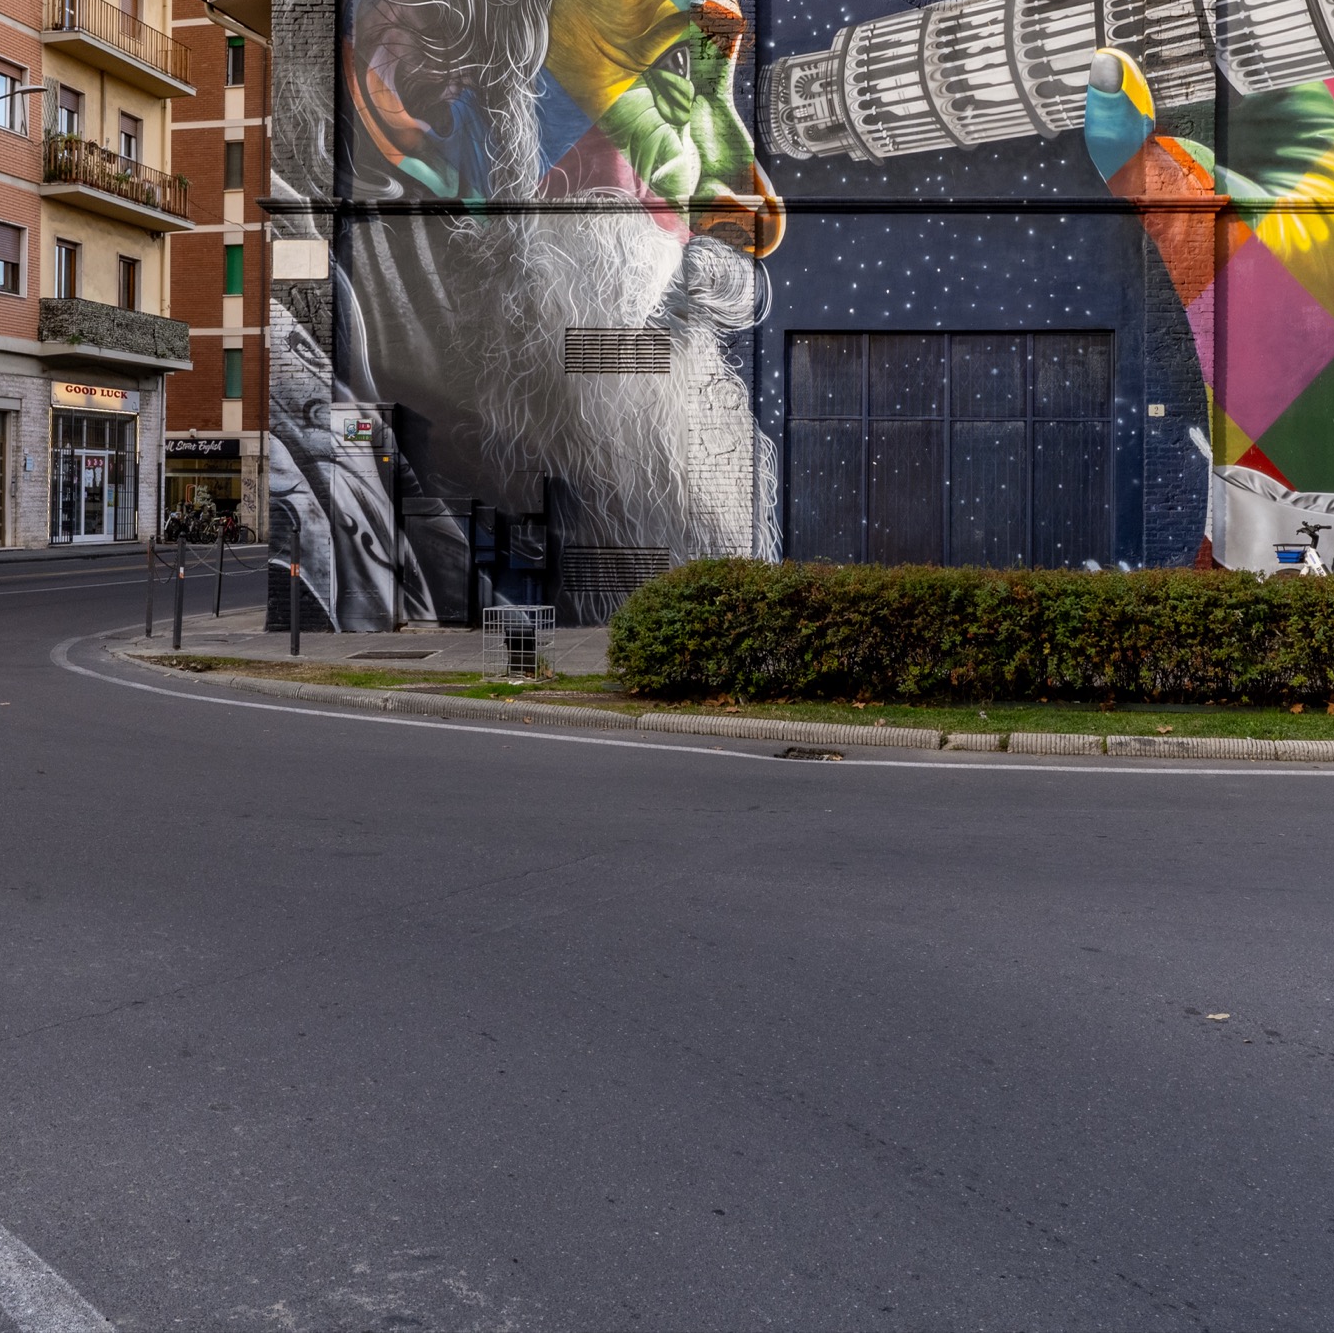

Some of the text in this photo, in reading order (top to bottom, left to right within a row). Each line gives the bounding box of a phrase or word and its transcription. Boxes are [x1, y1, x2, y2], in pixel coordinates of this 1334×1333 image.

[65, 384, 128, 400] GOOD LUCK
[1154, 406, 1159, 415] 2
[175, 440, 197, 451] Street
[197, 440, 222, 455] English
